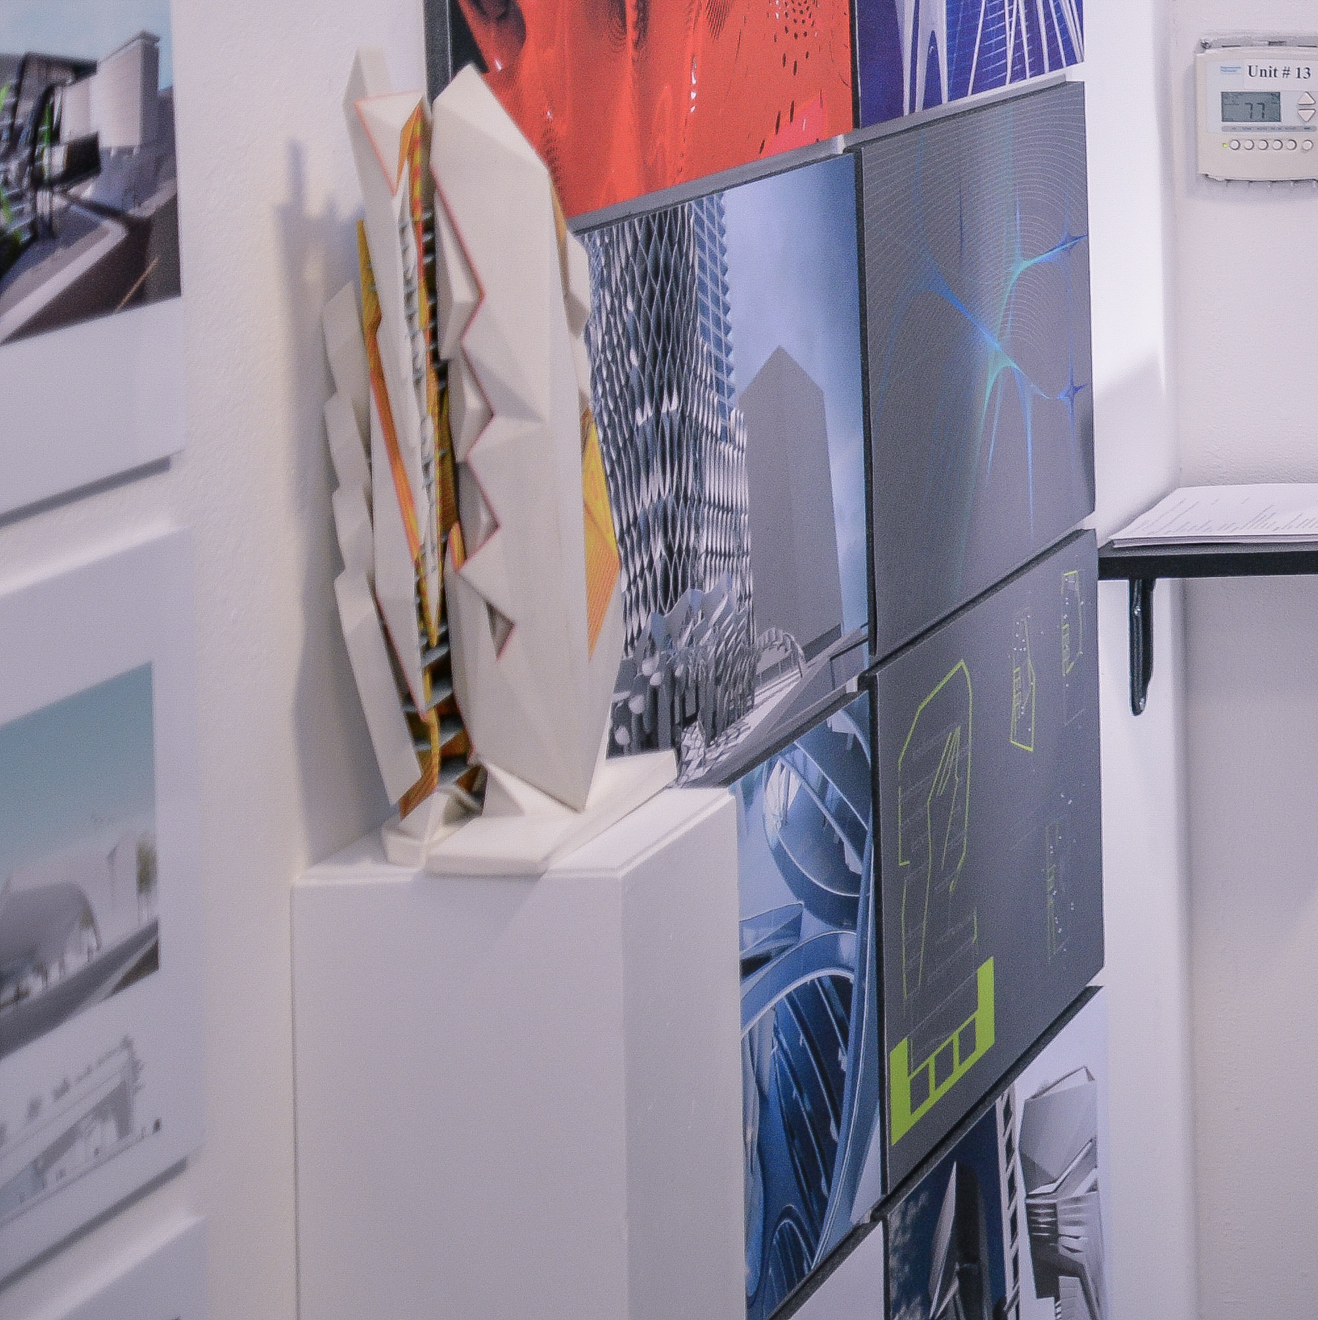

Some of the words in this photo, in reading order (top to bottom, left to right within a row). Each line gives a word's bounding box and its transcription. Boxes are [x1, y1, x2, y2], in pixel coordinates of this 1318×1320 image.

[1248, 64, 1278, 78] Unit
[1282, 66, 1291, 79] #
[1295, 67, 1311, 79] 13
[1244, 102, 1265, 119] 77
